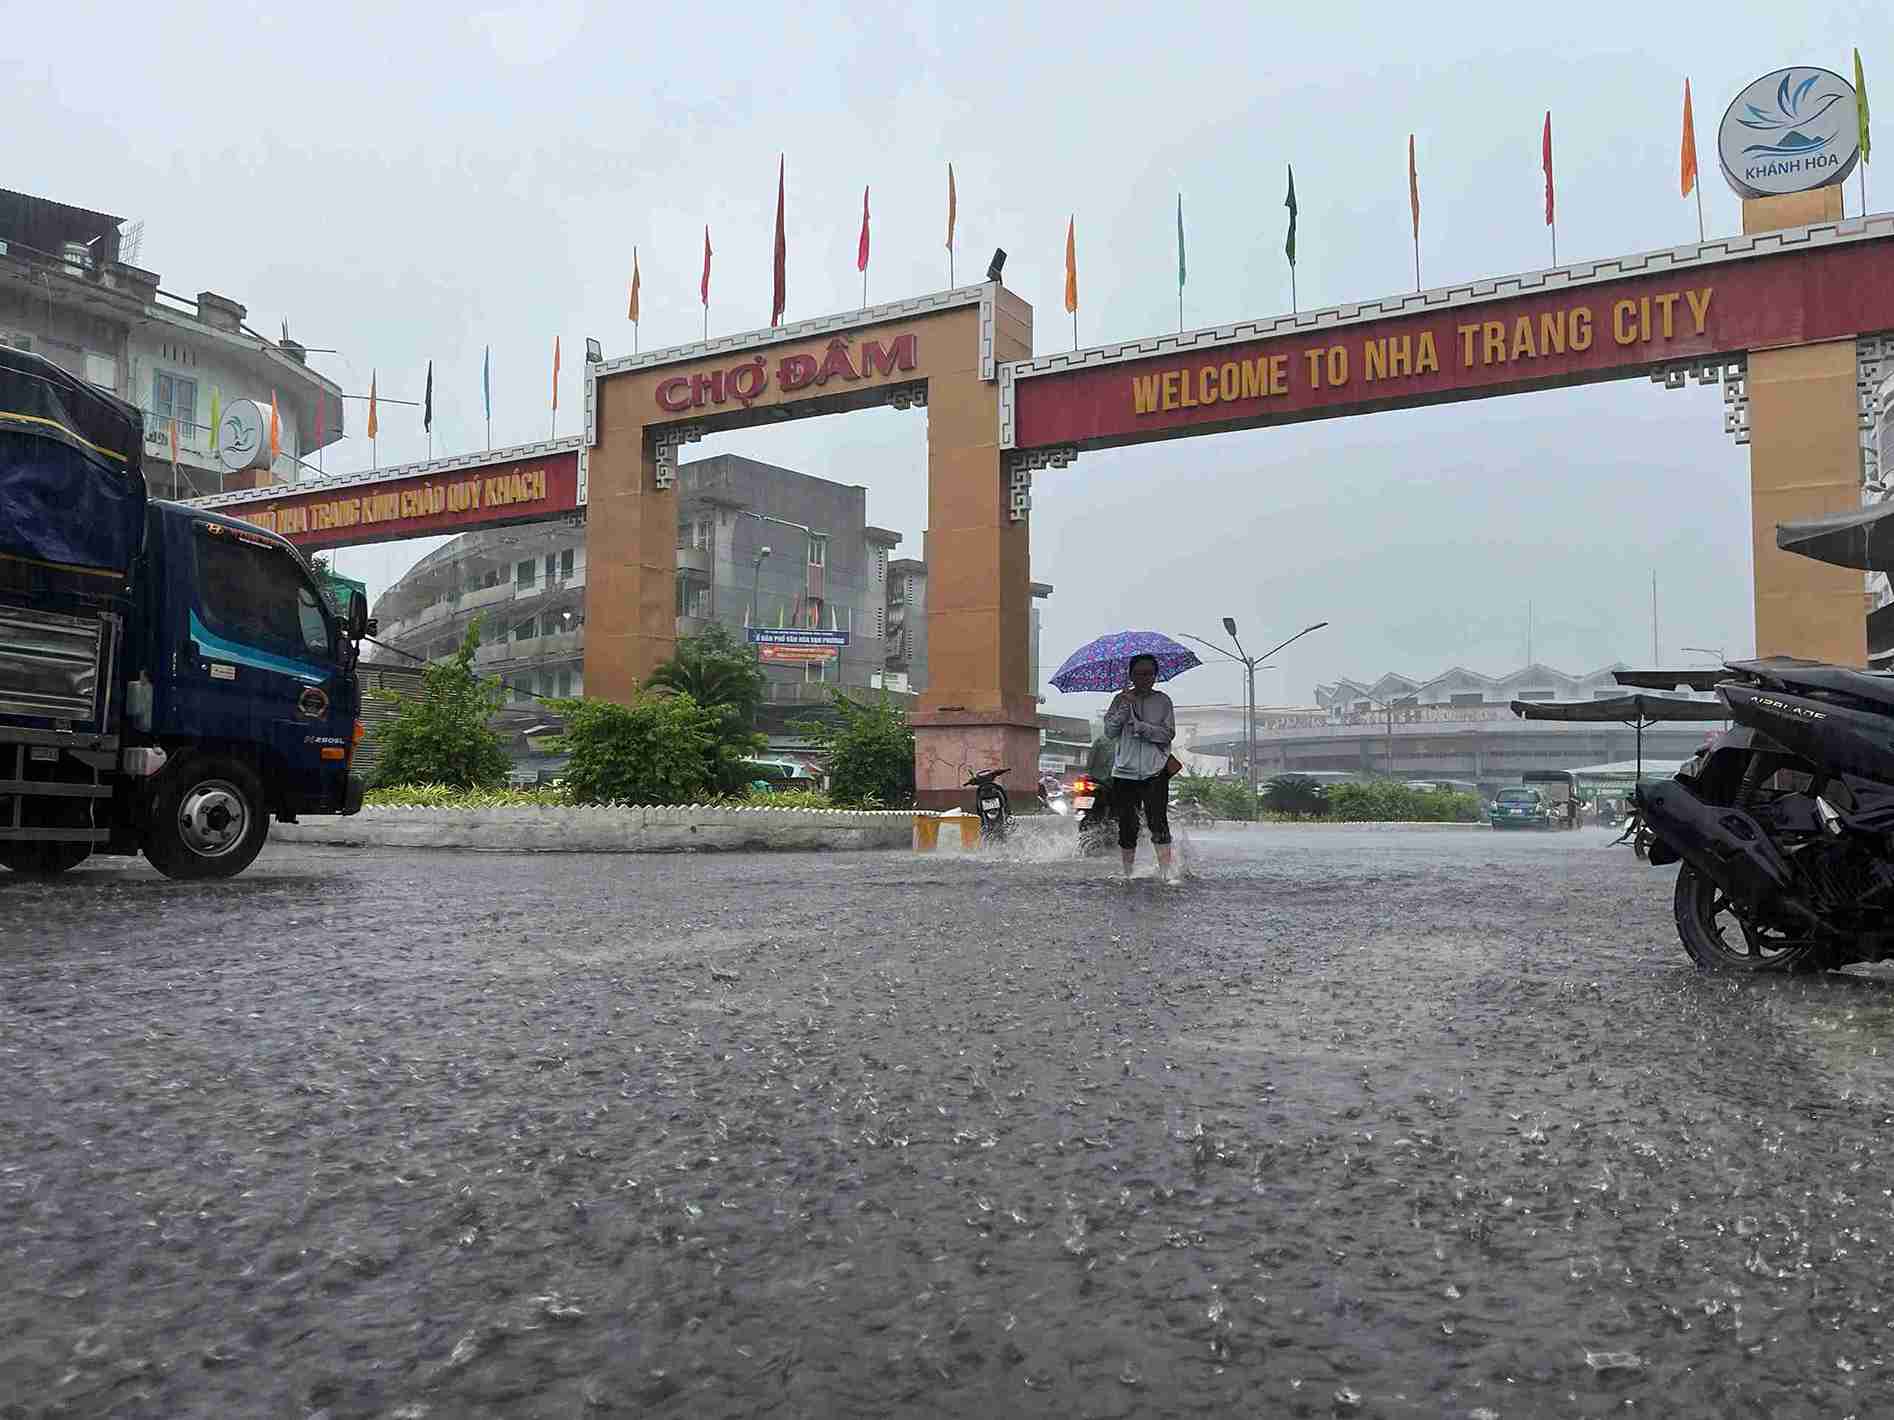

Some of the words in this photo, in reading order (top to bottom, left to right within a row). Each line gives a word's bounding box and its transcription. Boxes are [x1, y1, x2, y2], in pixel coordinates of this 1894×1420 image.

[1132, 354, 1290, 414] WELCOME
[1304, 345, 1350, 389] TO
[1364, 331, 1440, 382] NHA
[1457, 306, 1594, 368] TRANG
[1612, 287, 1714, 346] CITY
[655, 355, 768, 412] CHỢ
[309, 499, 361, 531] TRANG
[401, 481, 447, 518] CHÀO
[447, 473, 481, 513] QUÝ
[484, 466, 546, 507] KHÁCH
